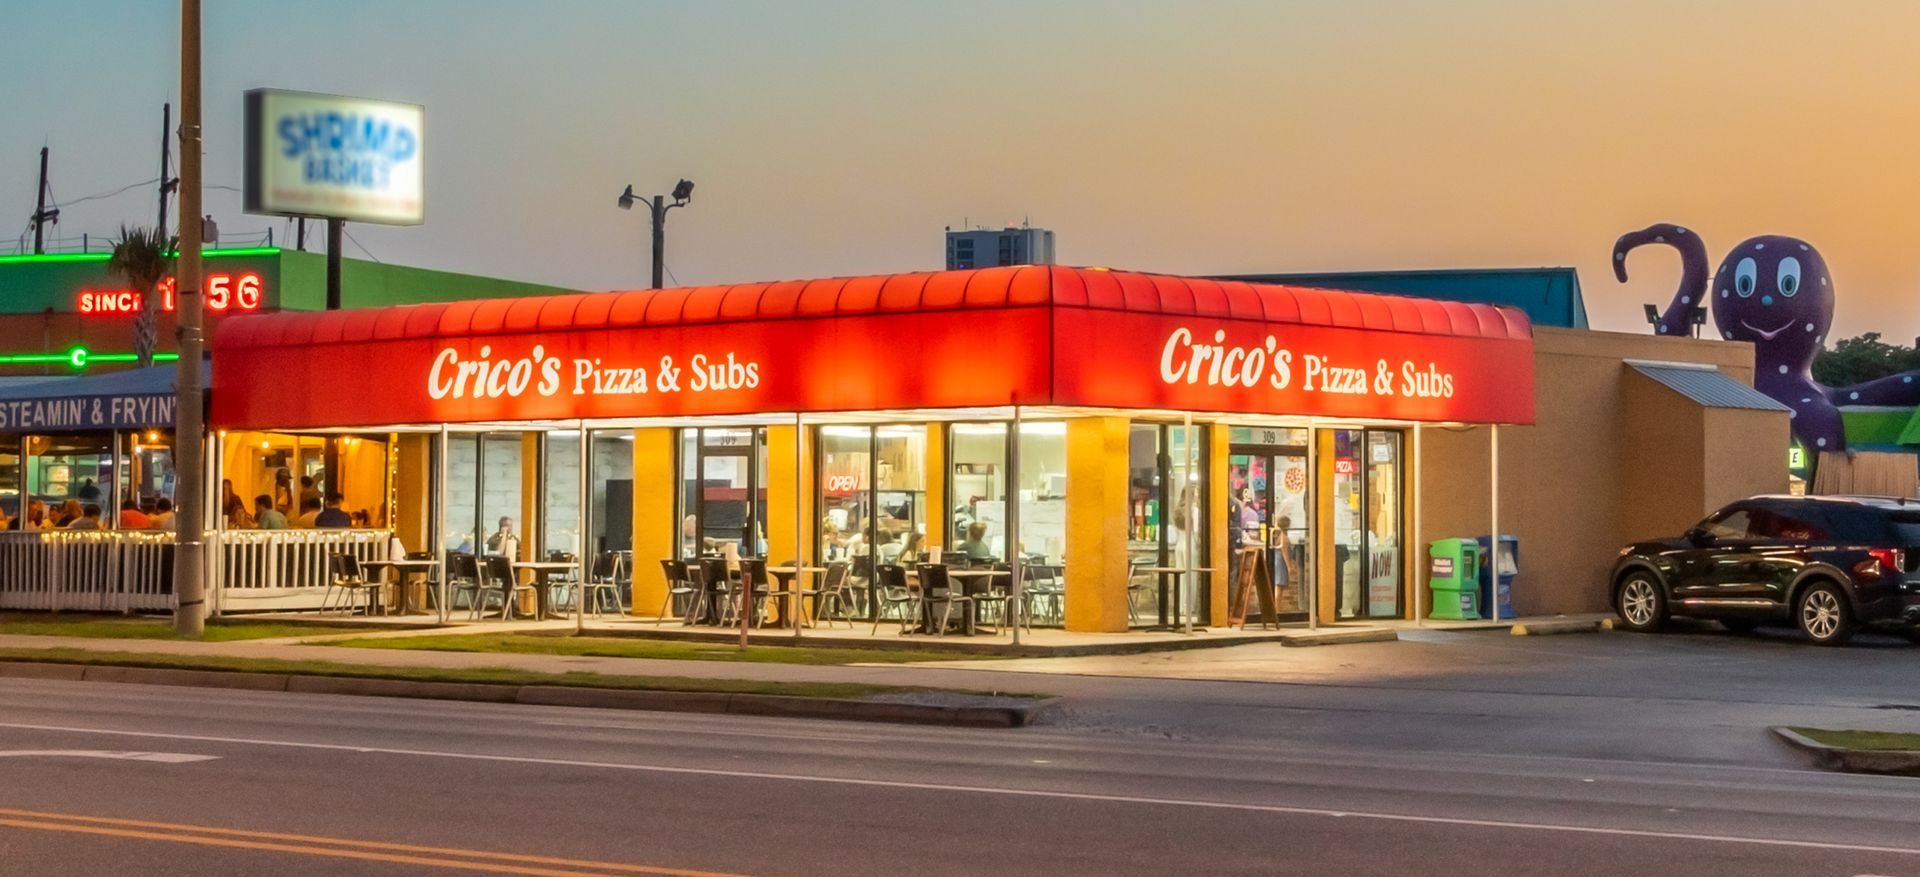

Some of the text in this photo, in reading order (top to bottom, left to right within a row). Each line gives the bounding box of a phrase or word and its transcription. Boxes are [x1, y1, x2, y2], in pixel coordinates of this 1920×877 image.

[277, 112, 416, 160] SHRIMP
[157, 275, 260, 311] 156
[428, 345, 760, 400] Crico's Pizza & Subs
[1160, 327, 1454, 399] Crico's Pizza & Subs
[91, 399, 104, 425] &
[111, 396, 177, 425] FRYIN'
[1263, 430, 1276, 444] 309
[1335, 460, 1353, 473] PIZZA
[829, 475, 859, 492] OPEN
[1371, 551, 1393, 579] NOW
